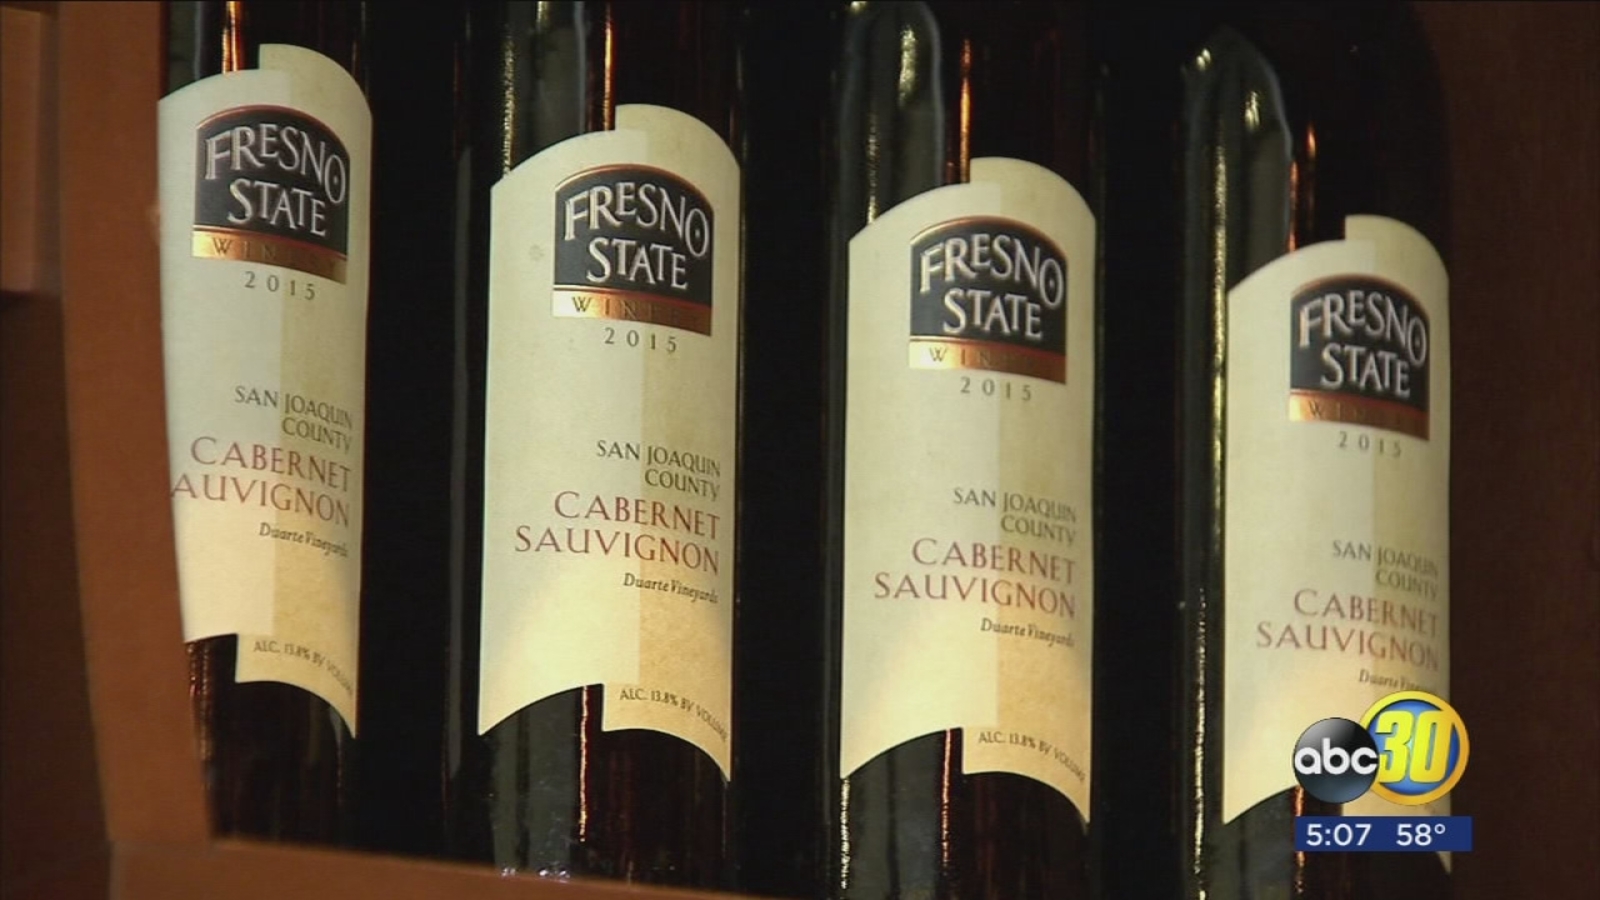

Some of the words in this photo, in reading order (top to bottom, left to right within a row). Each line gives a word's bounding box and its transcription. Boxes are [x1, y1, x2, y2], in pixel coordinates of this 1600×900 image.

[205, 123, 346, 204] FRESNO
[227, 178, 326, 237] STATE
[564, 181, 710, 257] FRESNO
[244, 270, 316, 301] 2015
[586, 236, 688, 290] STATE
[919, 233, 1063, 309] FRESNO
[942, 287, 1043, 340] STATE
[1298, 289, 1427, 368] FRESNO
[604, 327, 676, 353] 2015
[960, 376, 1032, 402] 2015
[1320, 342, 1410, 399] STATE
[234, 385, 279, 408] SAN
[284, 393, 352, 428] JOAQUIN
[281, 417, 351, 451] COUNTY
[1338, 431, 1402, 458] 2015
[190, 436, 351, 492] CABERNET
[597, 440, 639, 461] SAN
[646, 446, 720, 477] JOAQUIN
[171, 473, 350, 528] AUVIGNON
[645, 469, 720, 501] COUNTY
[953, 487, 996, 508] SAN
[1003, 492, 1076, 523] JOAQUIN
[259, 521, 304, 544] Duarte
[554, 491, 720, 540] CABERNET
[1001, 515, 1076, 546] COUNTY
[514, 525, 719, 576] SAUVIGNON
[912, 537, 1076, 585] CABERNET
[1332, 540, 1371, 561] SAN
[623, 573, 669, 592] Duarte
[874, 571, 1075, 620] SAUVIGNON
[980, 617, 1026, 637] Duarte
[1294, 589, 1439, 638] CABERNET
[1256, 622, 1438, 672] SAUVIGNON
[619, 687, 649, 701] ALC.
[650, 690, 679, 707] 13.8%
[680, 697, 695, 712] BY
[1009, 732, 1037, 750] 13.8%
[1038, 739, 1052, 756] BY
